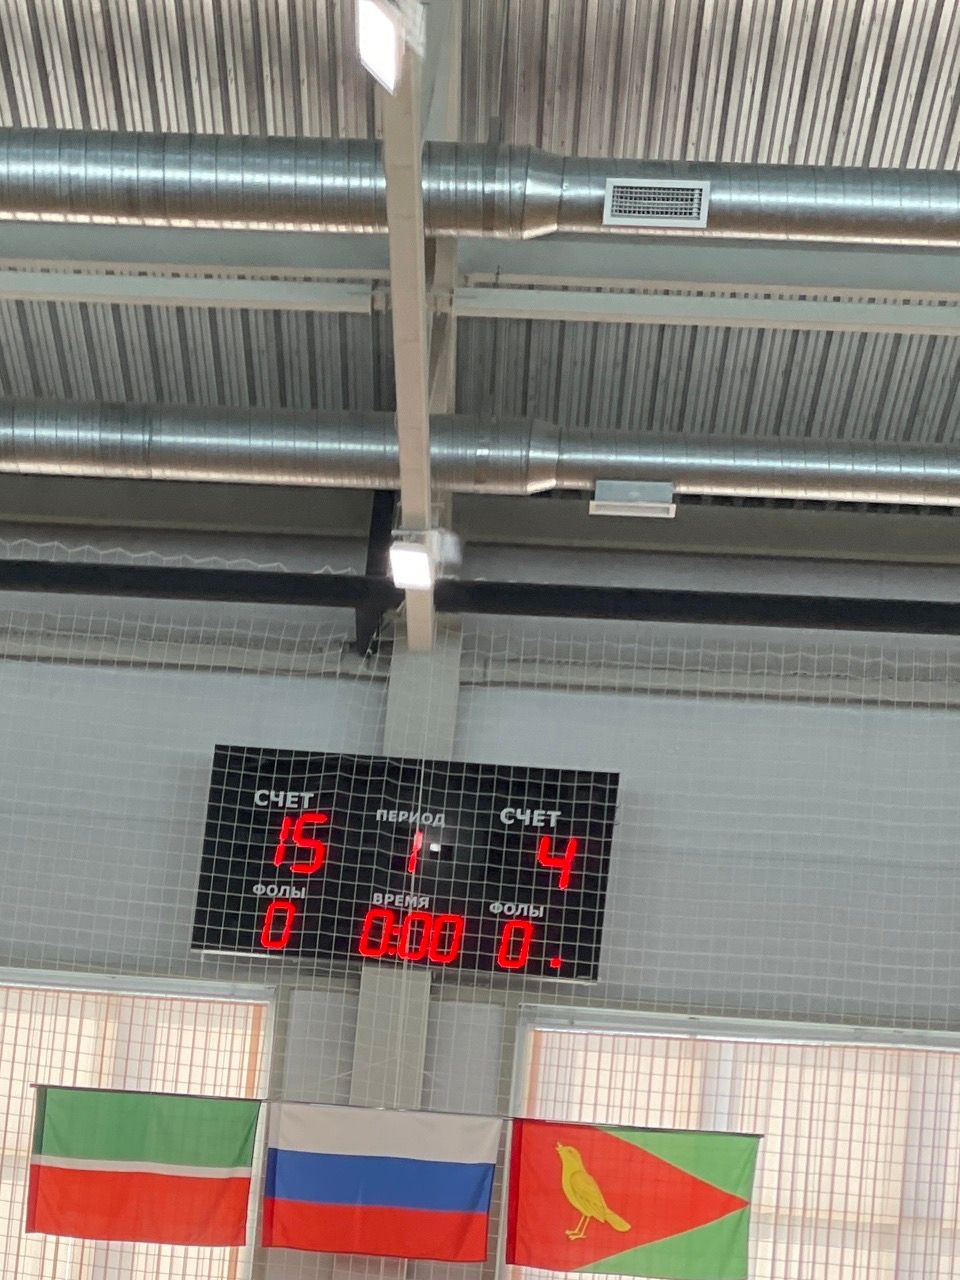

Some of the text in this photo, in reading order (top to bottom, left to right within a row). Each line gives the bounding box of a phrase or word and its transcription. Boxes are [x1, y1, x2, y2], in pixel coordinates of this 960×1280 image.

[253, 789, 315, 809] СЧЕТ
[376, 808, 446, 828] ПЕРИОД
[500, 807, 562, 827] СЧЕТ
[273, 812, 328, 875] 15
[537, 835, 578, 890] 4
[252, 883, 306, 899] ФОЛЫ
[372, 892, 430, 909] ВРЕМЯ
[489, 901, 544, 918] ФОЛЫ
[261, 901, 296, 949] 0
[358, 908, 464, 964] 0:00
